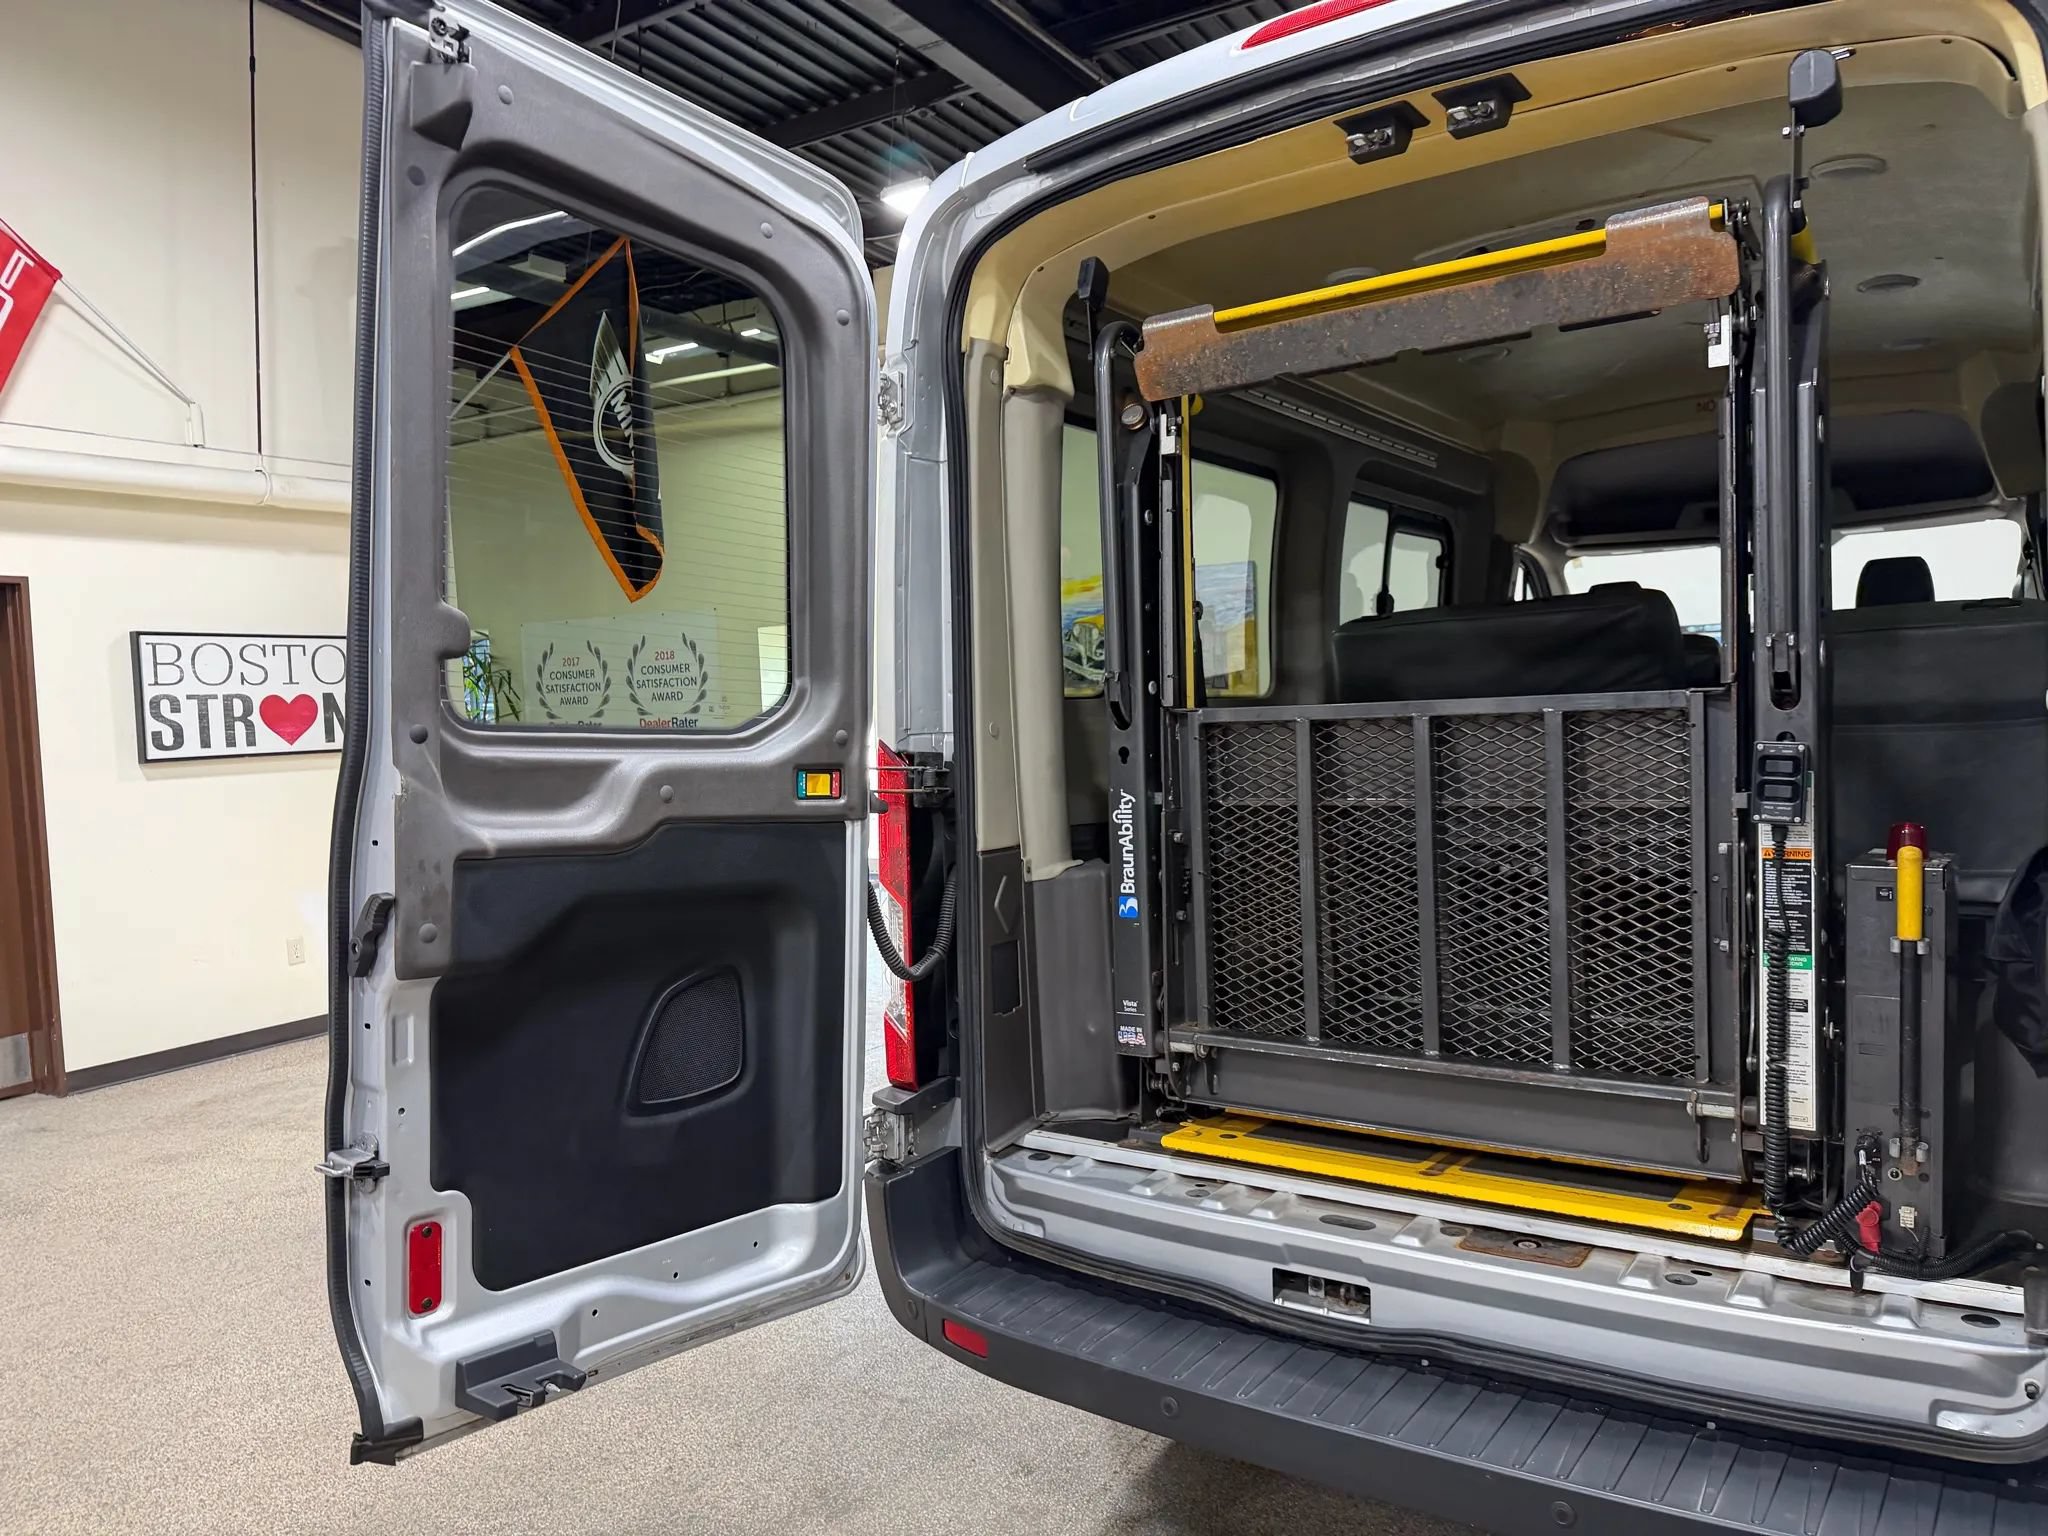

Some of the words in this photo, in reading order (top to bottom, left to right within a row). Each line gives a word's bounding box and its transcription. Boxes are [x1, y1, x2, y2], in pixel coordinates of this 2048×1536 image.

[562, 656, 580, 667] 2017
[654, 650, 675, 661] 2018
[145, 642, 345, 686] BOSTO
[640, 663, 691, 676] CONSUMER
[549, 668, 596, 681] CONSUMER
[545, 682, 601, 694] SATISFACTION
[636, 676, 697, 689] SATISFACTION
[559, 696, 589, 706] AWARD
[651, 691, 684, 702] AWARD
[639, 716, 699, 728] DealerRater
[1113, 791, 1136, 894] BraunAbility
[1122, 999, 1138, 1007] Vista
[1119, 1025, 1136, 1033] MADE
[1117, 1030, 1147, 1046] USA
